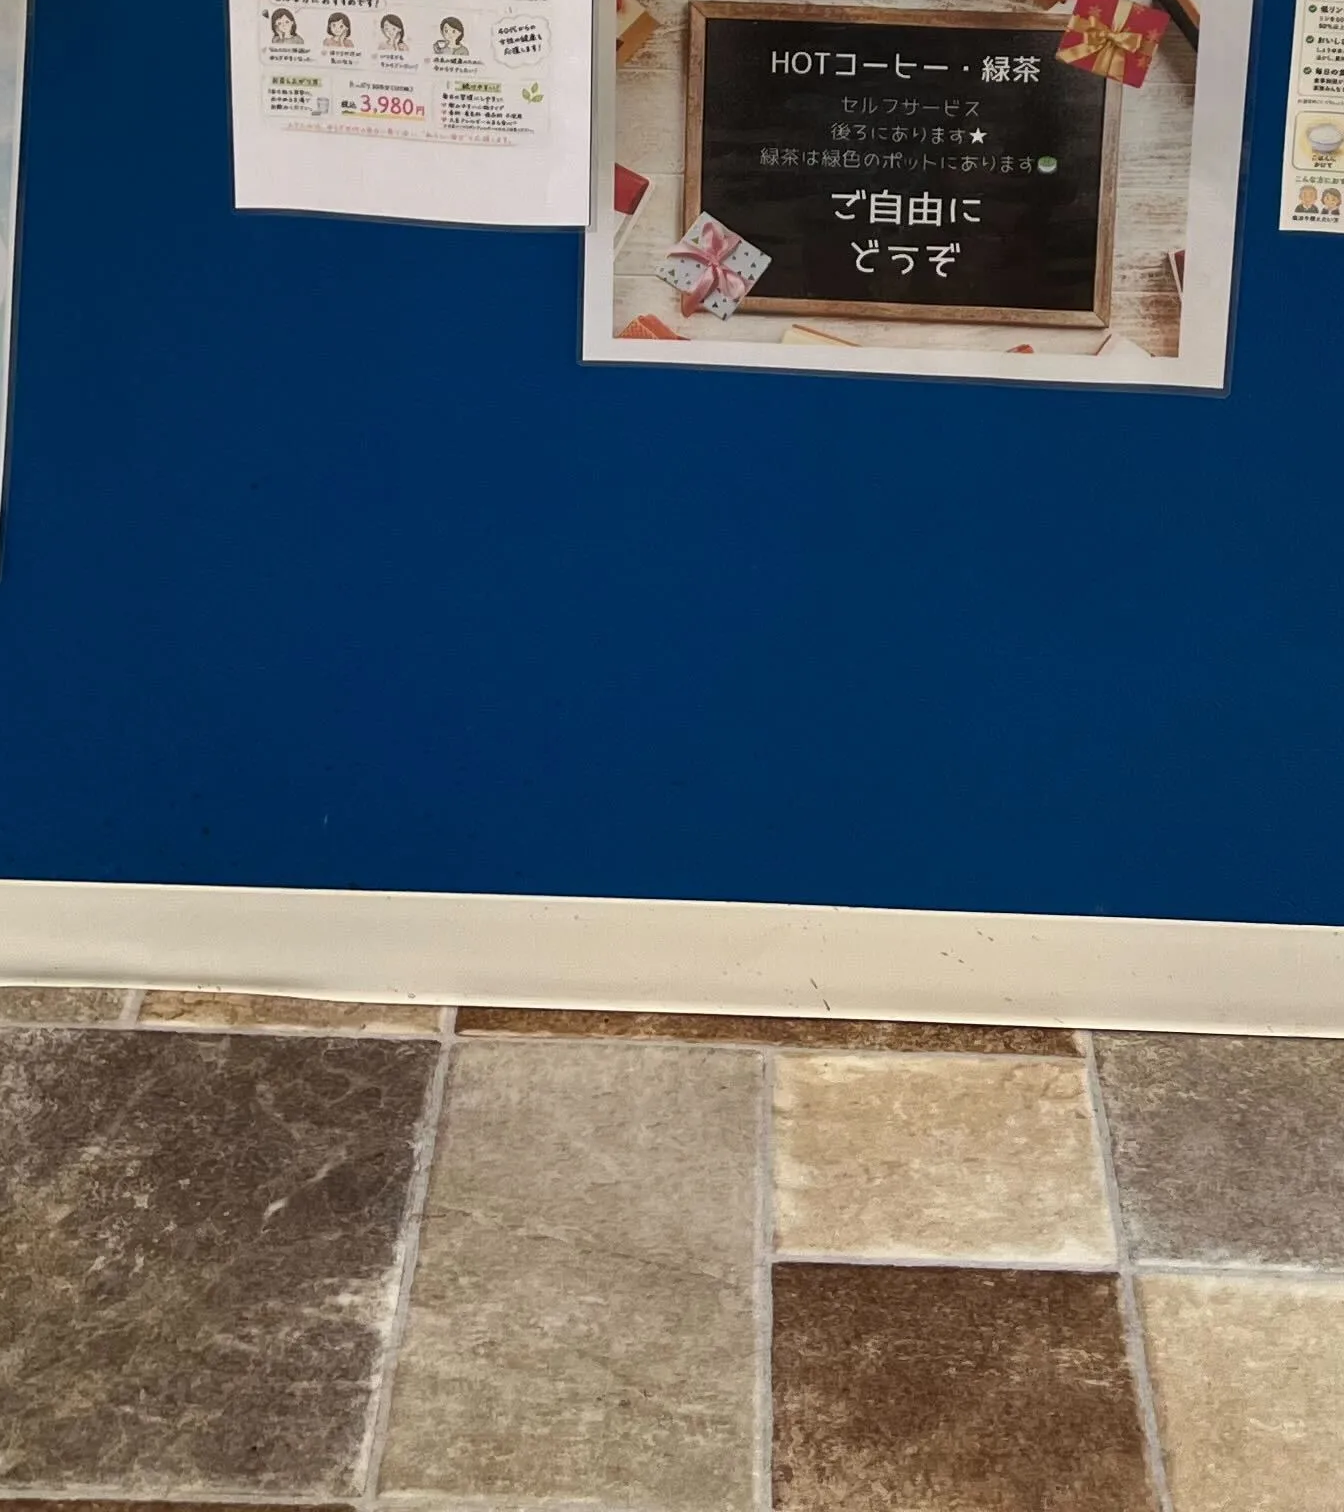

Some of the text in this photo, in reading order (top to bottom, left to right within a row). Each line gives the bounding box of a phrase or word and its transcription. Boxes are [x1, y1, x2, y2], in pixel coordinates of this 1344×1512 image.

[771, 50, 1041, 84] HOTコーヒー・緑茶
[841, 96, 981, 117] セルフサービス
[760, 147, 1037, 174] 緑茶は緑色のポットにあります
[831, 189, 981, 227] ご自由に
[850, 240, 962, 278] どうぞ
